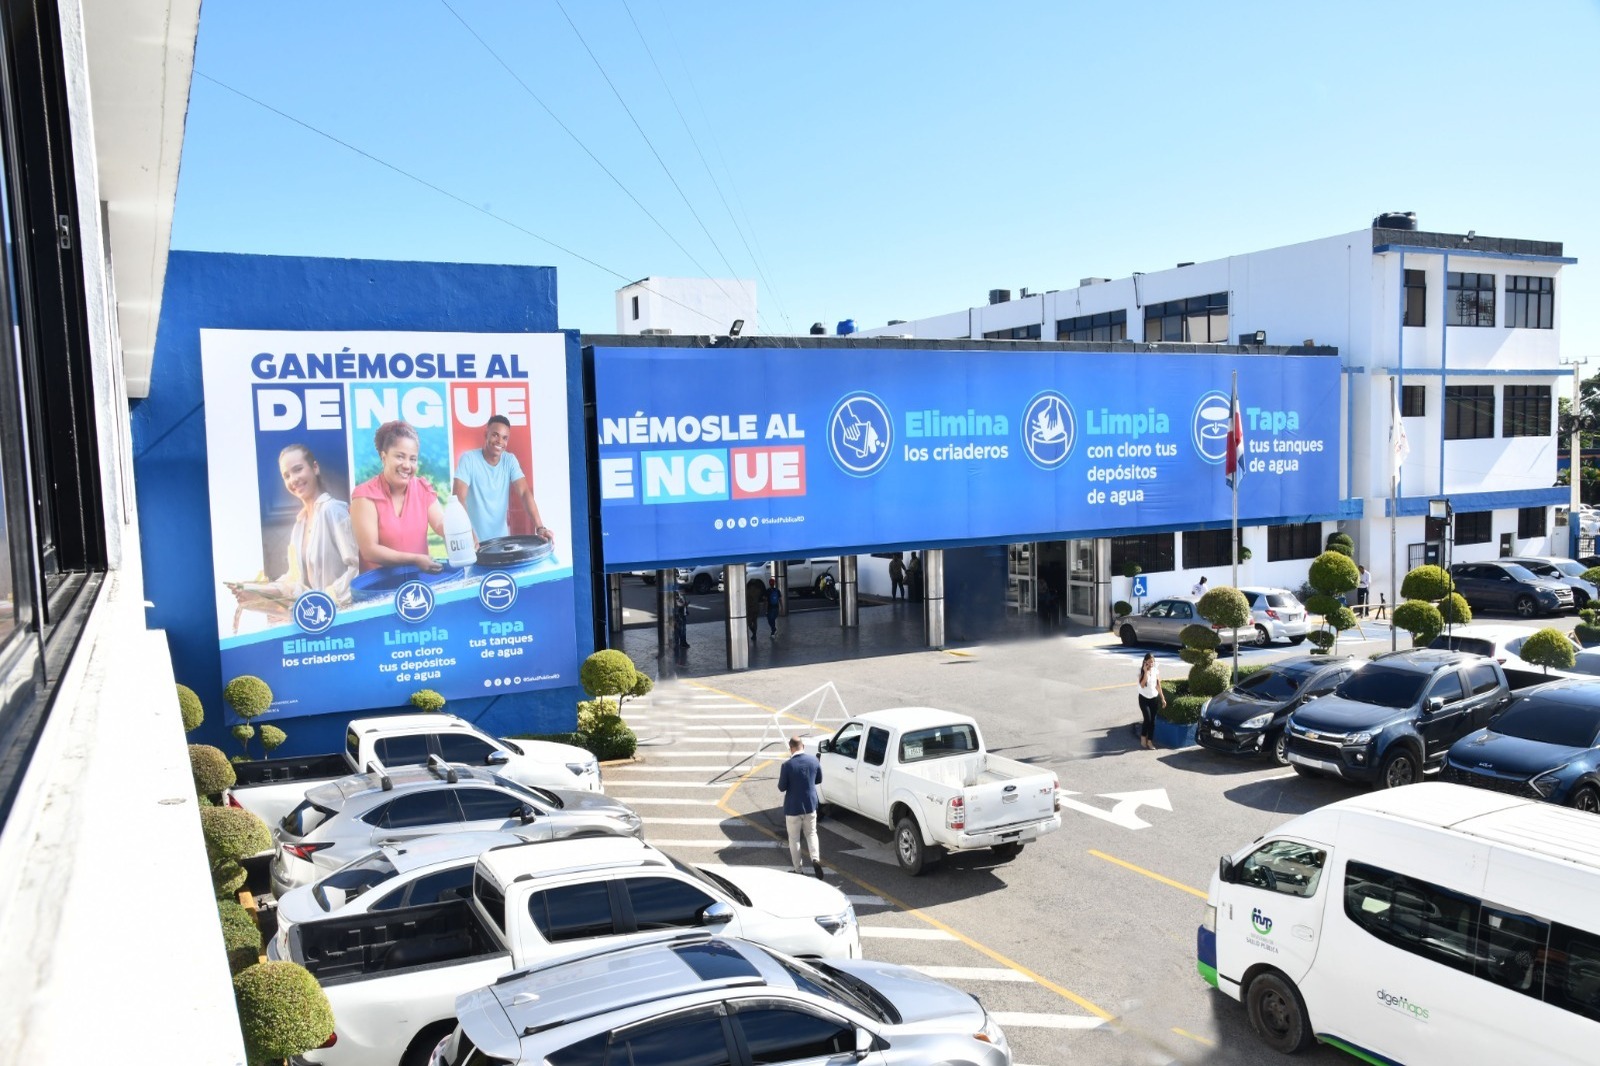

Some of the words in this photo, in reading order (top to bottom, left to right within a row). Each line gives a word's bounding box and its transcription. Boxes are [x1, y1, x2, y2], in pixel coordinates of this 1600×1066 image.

[251, 346, 477, 380] GANÉMOSLE
[485, 353, 529, 379] AL
[256, 386, 527, 431] DENGUE
[765, 413, 805, 439] AL
[905, 408, 1009, 438] Elimina
[1087, 407, 1170, 440] Limpia
[1246, 407, 1299, 435] Tapa
[904, 444, 929, 462] los
[933, 439, 1009, 461] criaderos
[1087, 444, 1114, 459] con
[1117, 440, 1151, 458] cloro
[1155, 441, 1177, 457] tus
[1249, 438, 1270, 453] tus
[1273, 437, 1324, 455] tanques
[1087, 463, 1157, 484] depósitos
[1249, 457, 1266, 473] de
[1268, 459, 1299, 475] agua
[1087, 488, 1106, 505] de
[1109, 489, 1144, 507] agua
[384, 626, 449, 647] Limpia
[479, 619, 524, 637] Tapa
[282, 635, 355, 656] Elimina
[469, 638, 487, 648] tus
[489, 632, 533, 647] tanques
[282, 656, 299, 668] los
[302, 651, 355, 666] criaderos
[391, 648, 414, 660] con
[416, 645, 443, 658] cloro
[481, 647, 496, 659] de
[497, 645, 523, 659] agua
[379, 661, 398, 673] tus
[400, 655, 456, 672] depósitos
[396, 671, 412, 682] de
[414, 669, 441, 683] agua
[1376, 989, 1430, 1019] digemaps
